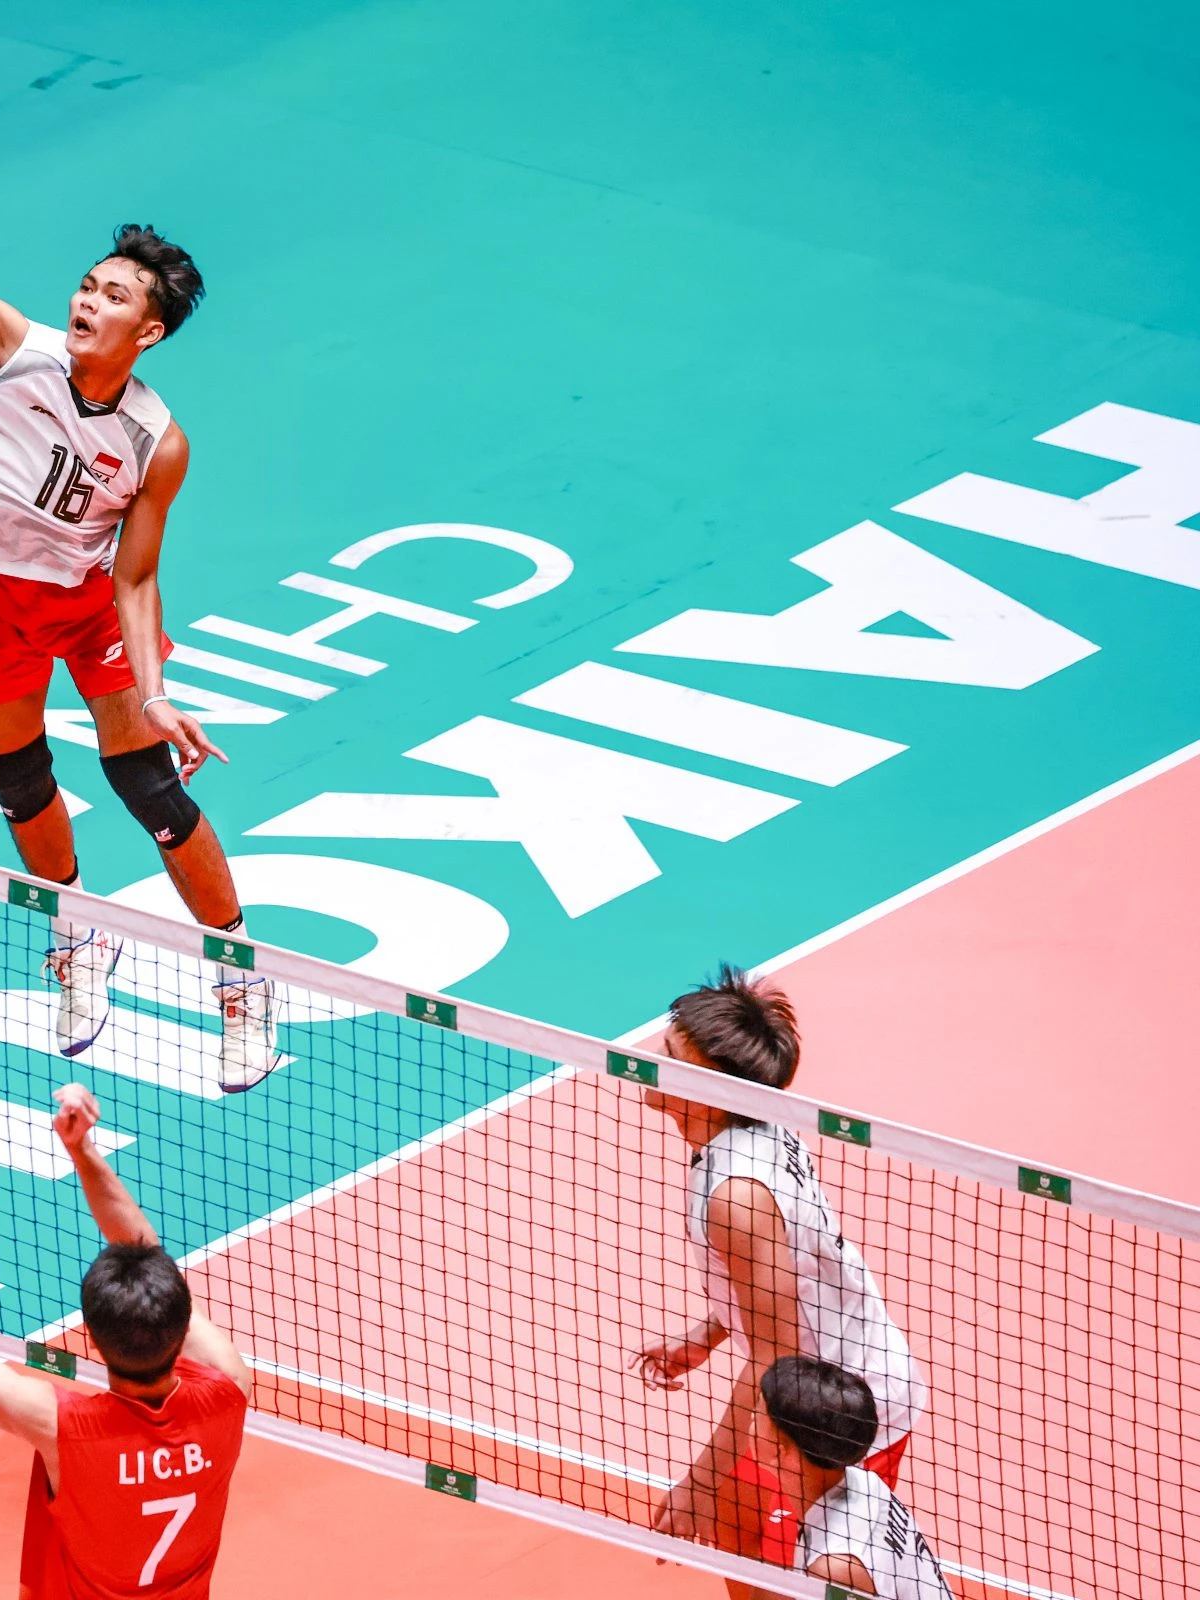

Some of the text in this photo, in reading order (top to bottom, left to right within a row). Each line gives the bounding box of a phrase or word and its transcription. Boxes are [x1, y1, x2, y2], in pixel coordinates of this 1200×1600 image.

[34, 443, 95, 524] 16
[118, 1443, 213, 1485] LI C.B.
[138, 1492, 197, 1587] 7
